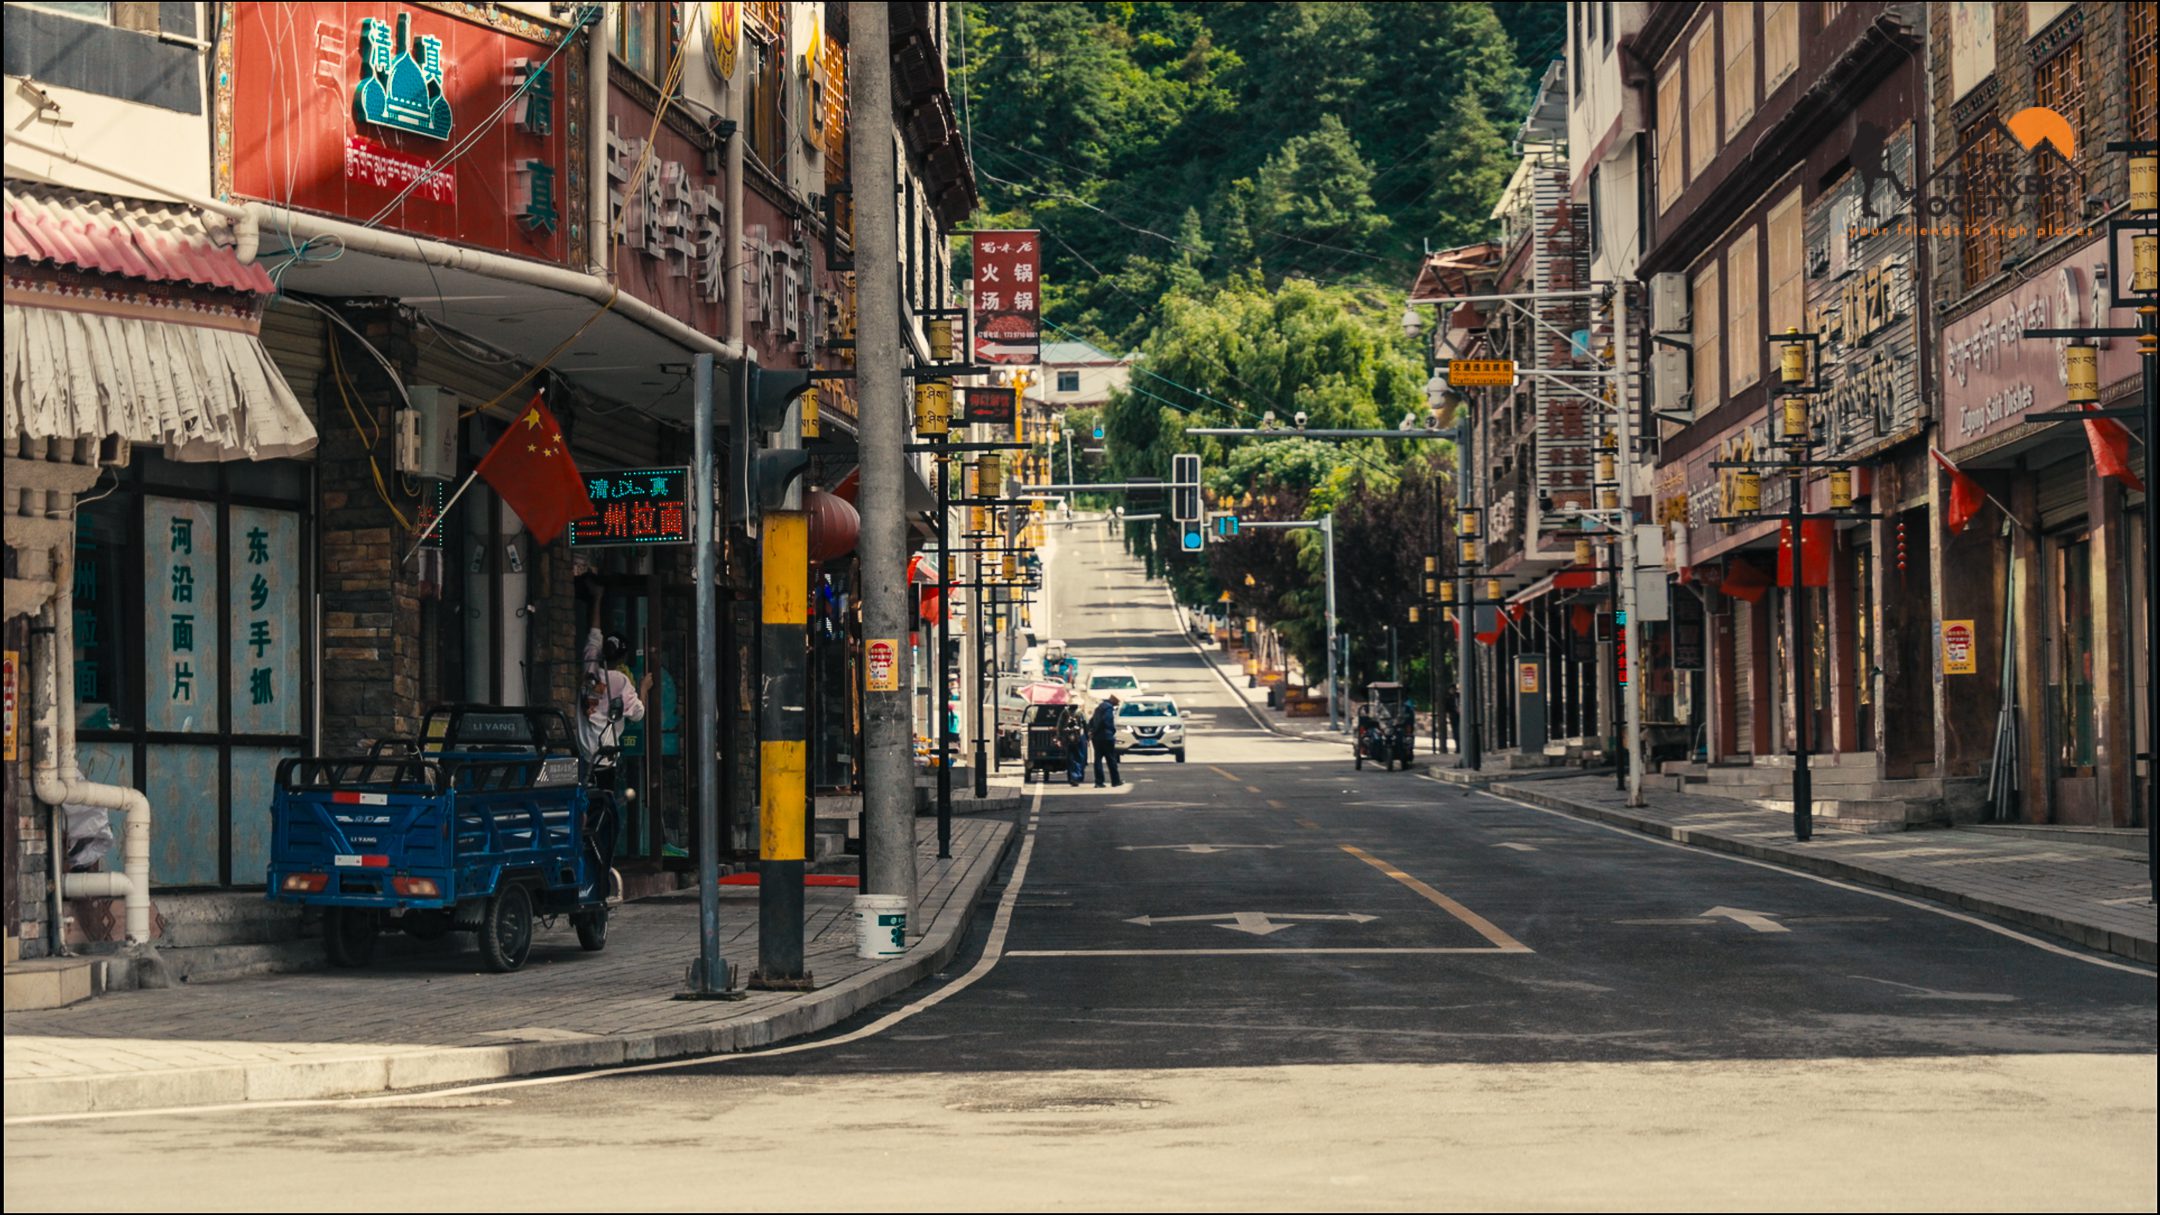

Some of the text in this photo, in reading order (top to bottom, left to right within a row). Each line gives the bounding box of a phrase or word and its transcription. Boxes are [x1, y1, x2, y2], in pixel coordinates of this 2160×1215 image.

[368, 17, 444, 86] 清真
[522, 60, 558, 236] 清真
[981, 262, 1034, 282] 火锅
[981, 291, 1034, 311] 汤锅
[2004, 381, 2033, 417] Dishes
[171, 516, 194, 701] 河沿面片
[247, 526, 274, 705] 东乡手抓
[485, 723, 515, 731] YANG
